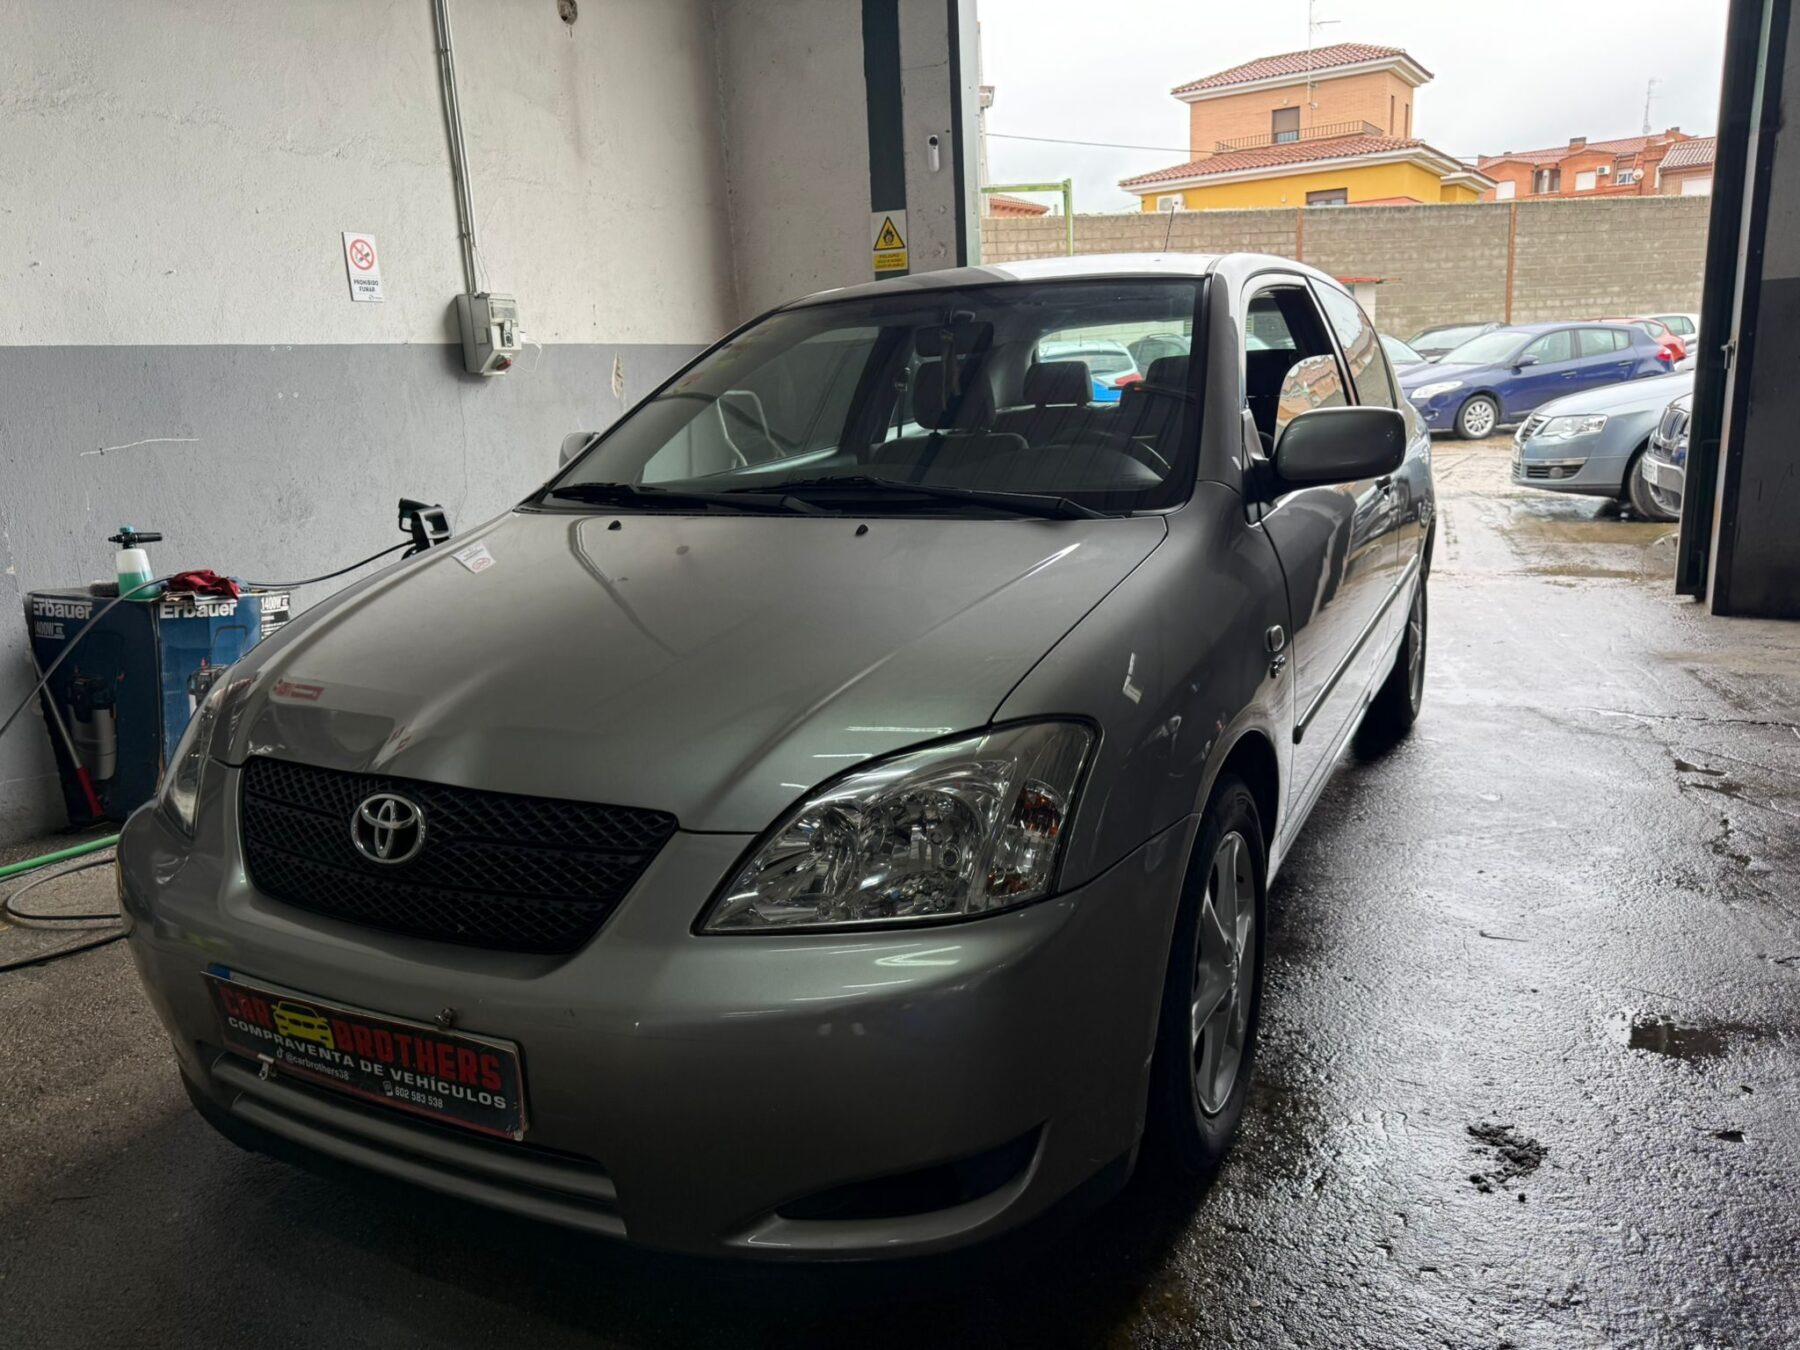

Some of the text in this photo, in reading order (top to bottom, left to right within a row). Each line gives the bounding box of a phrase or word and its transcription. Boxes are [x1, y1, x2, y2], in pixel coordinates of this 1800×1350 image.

[159, 601, 237, 619] Erbauer
[219, 984, 502, 1091] CAR BROTHERS
[228, 1017, 508, 1110] COMPRAVENTA DE VEHÍCULOS
